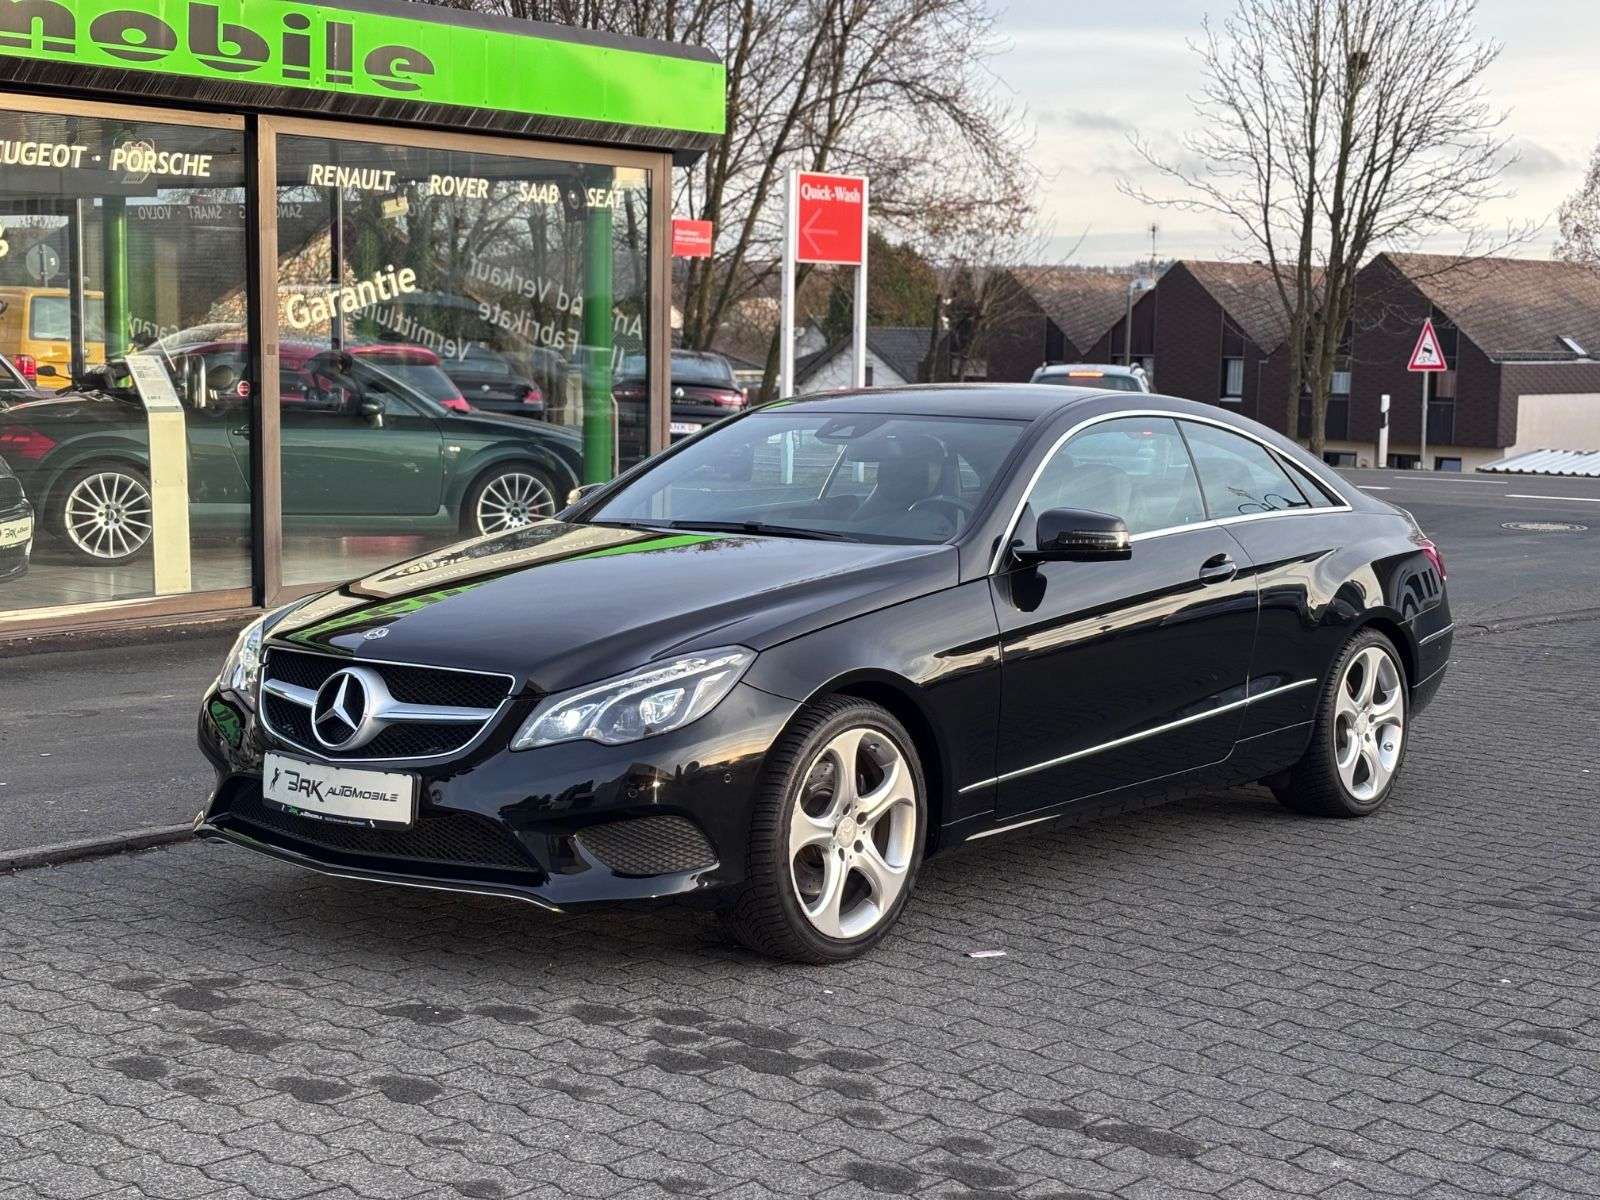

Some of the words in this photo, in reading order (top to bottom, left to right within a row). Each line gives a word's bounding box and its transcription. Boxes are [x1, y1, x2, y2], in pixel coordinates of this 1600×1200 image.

[111, 147, 213, 178] PORSCHE
[309, 164, 396, 192] RENAULT
[429, 174, 490, 199] ROVER
[518, 183, 559, 205] SAAB
[587, 188, 626, 208] SEAT
[285, 265, 418, 329] Garantie
